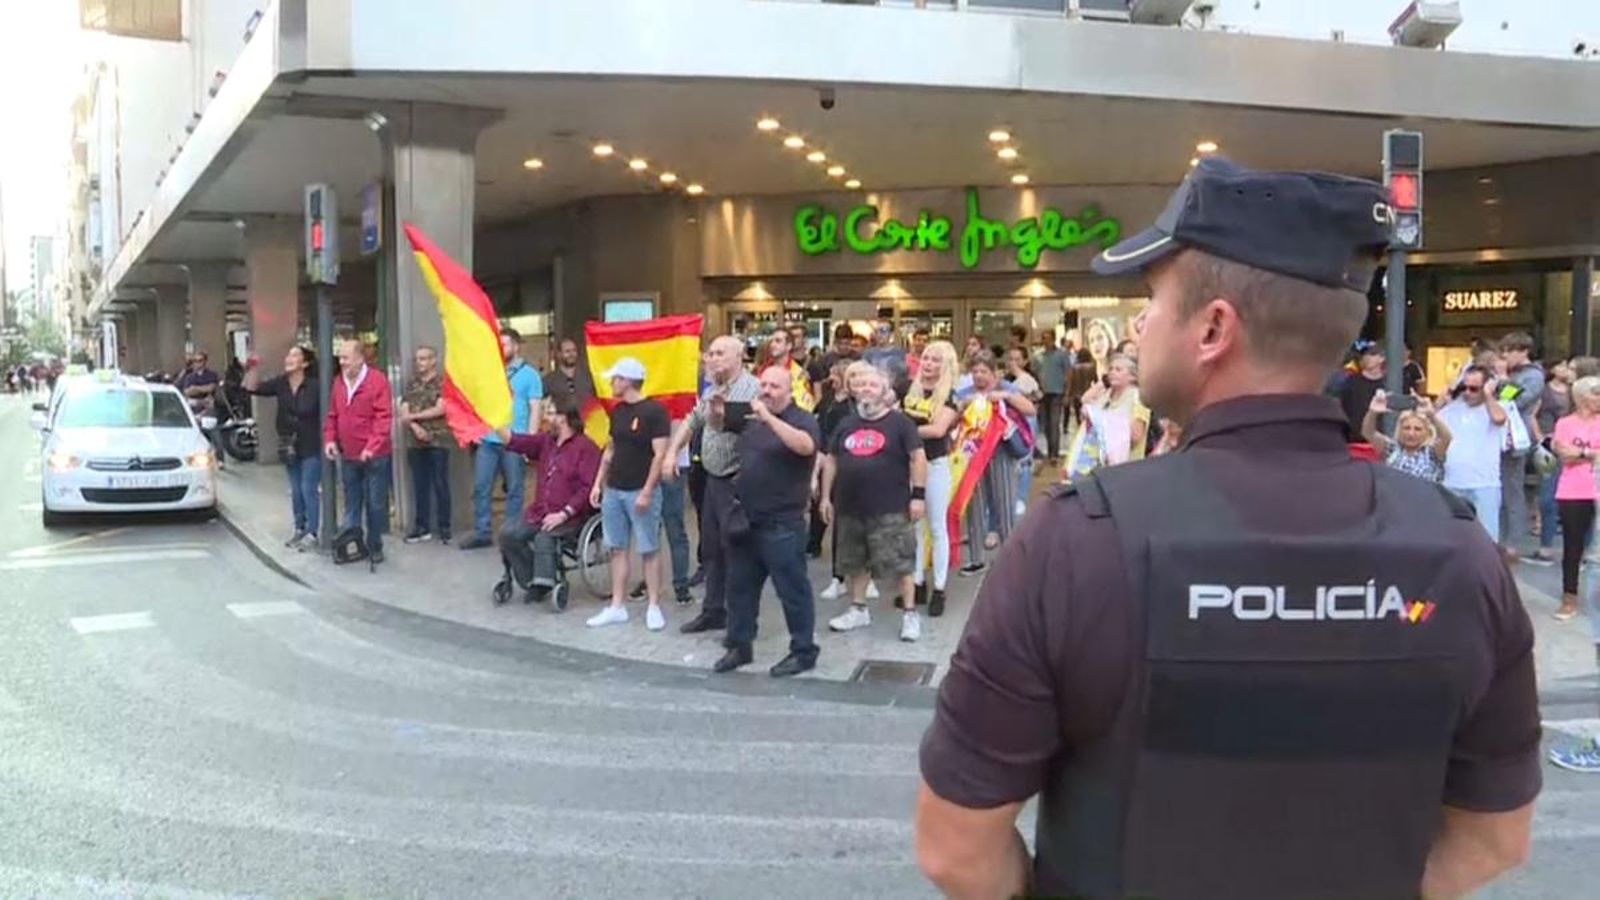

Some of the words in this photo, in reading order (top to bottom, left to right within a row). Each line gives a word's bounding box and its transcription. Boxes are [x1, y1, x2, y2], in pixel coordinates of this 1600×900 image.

[795, 205, 839, 254] El
[844, 205, 951, 253] Corte
[960, 186, 1120, 269] Inglés
[1444, 290, 1518, 310] SUAREZ
[1188, 578, 1408, 620] POLICÍA
